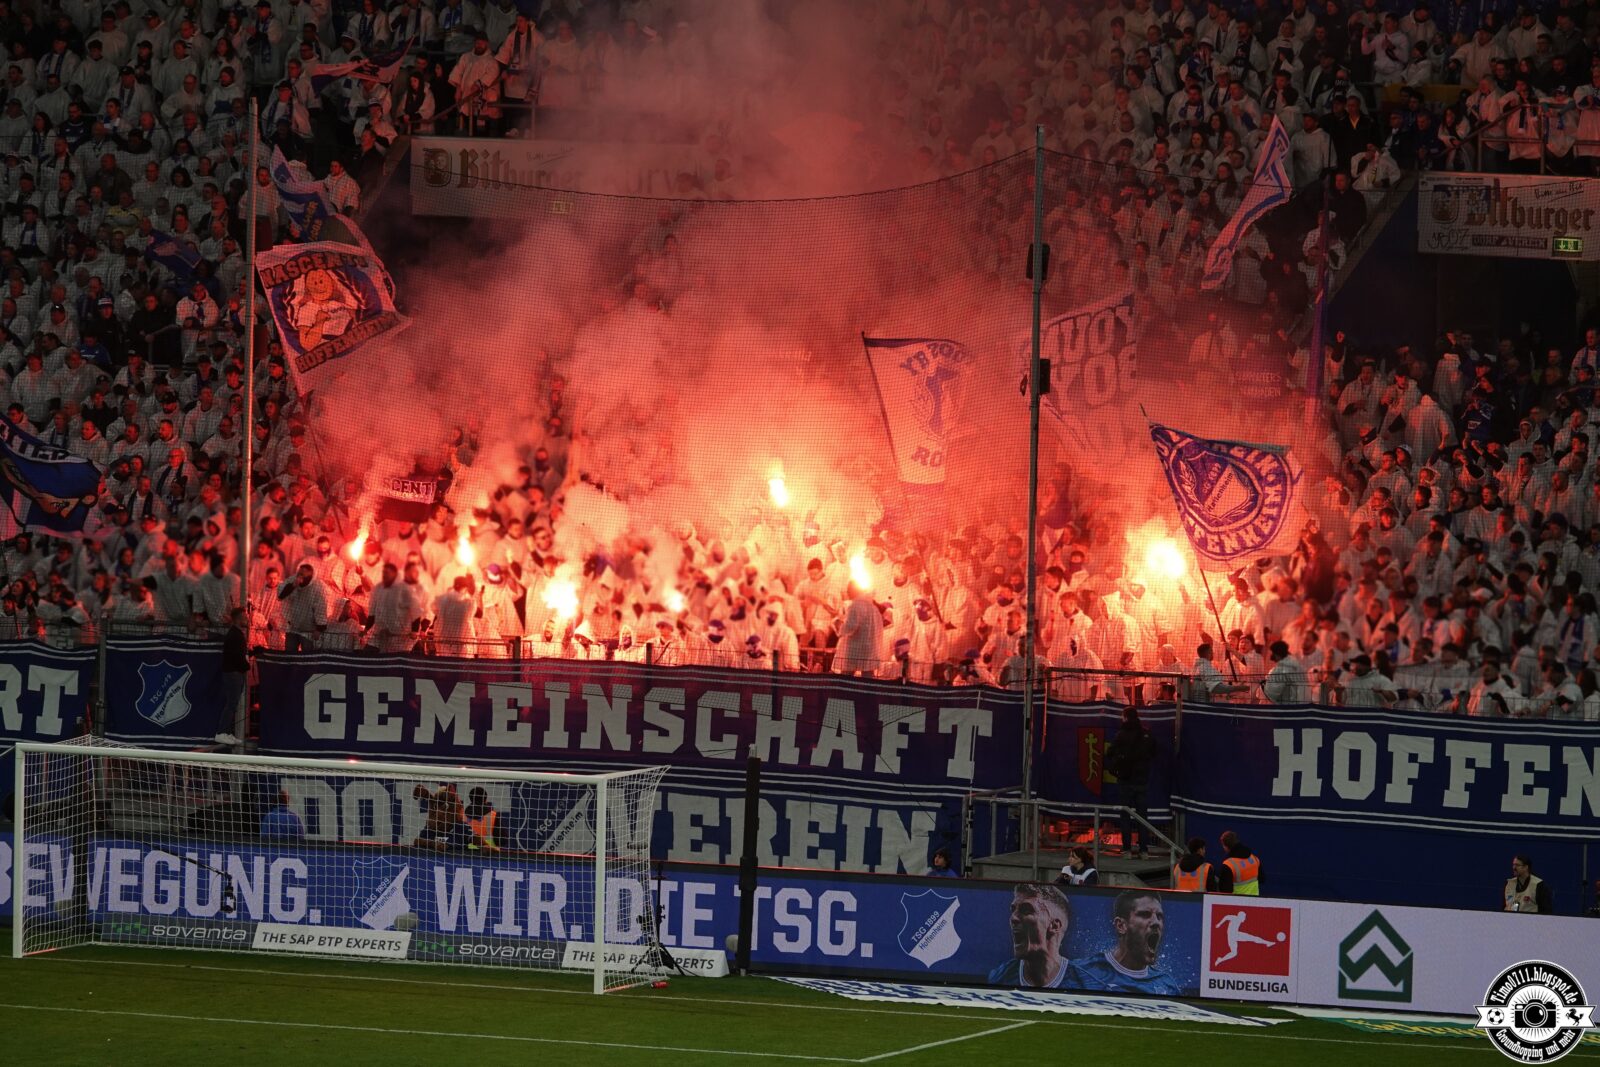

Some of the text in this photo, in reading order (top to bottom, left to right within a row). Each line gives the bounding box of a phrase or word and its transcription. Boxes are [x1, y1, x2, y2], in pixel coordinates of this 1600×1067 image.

[303, 672, 993, 779] GEMEINSCHAFT
[1271, 728, 1600, 816] HOFFEN
[603, 788, 936, 875] VEREIN
[433, 866, 582, 940] WIR.
[605, 876, 716, 948] DIE
[152, 923, 247, 941] sovanta
[261, 931, 402, 952] THE SAP BTP EXPERTS
[912, 910, 940, 943] TSG 1899
[919, 919, 947, 950] Hoffenheim
[458, 940, 556, 960] sovanta
[1208, 978, 1289, 993] BUNDESLIGA
